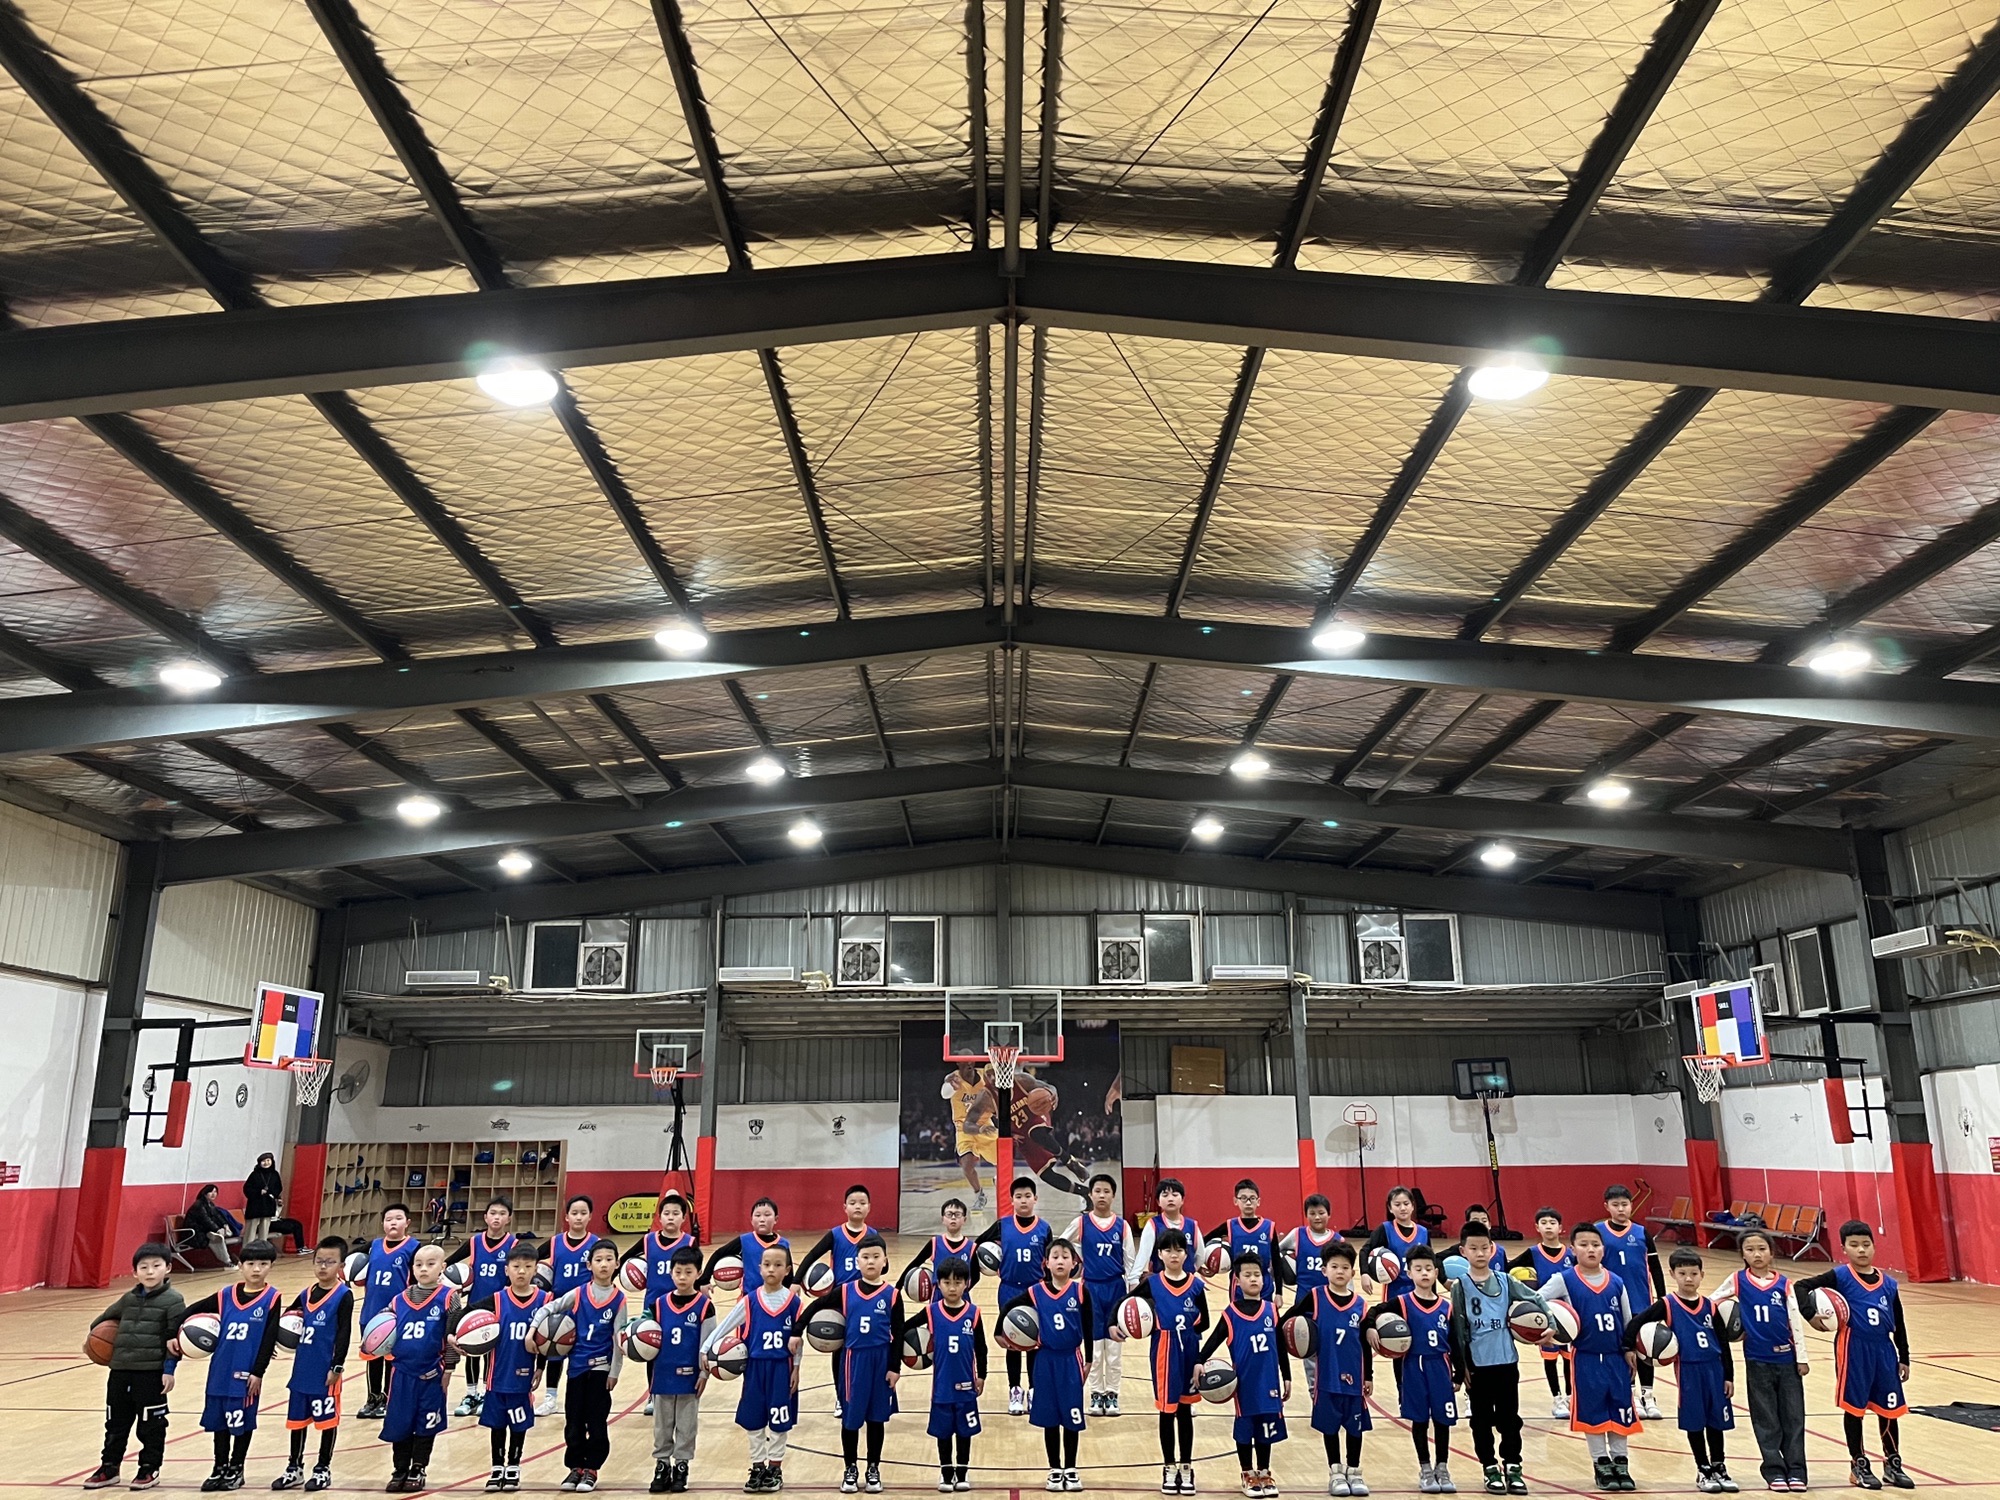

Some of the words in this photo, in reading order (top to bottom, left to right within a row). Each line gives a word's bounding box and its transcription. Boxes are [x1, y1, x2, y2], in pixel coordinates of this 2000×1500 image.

[1011, 1109, 1029, 1129] 23
[1016, 1248, 1031, 1262] 19
[1096, 1243, 1113, 1256] 77
[1619, 1251, 1625, 1265] 1
[479, 1263, 497, 1277] 39
[563, 1263, 579, 1278] 31
[1306, 1256, 1323, 1270] 32
[375, 1270, 392, 1286] 12
[1471, 1296, 1482, 1316] 8
[1753, 1304, 1770, 1322] 11
[859, 1316, 871, 1333] 5
[1053, 1313, 1065, 1330] 9
[1175, 1314, 1187, 1330] 2
[1594, 1313, 1615, 1332] 13
[1866, 1308, 1880, 1326] 9
[226, 1322, 249, 1341] 23
[402, 1321, 426, 1340] 26
[510, 1321, 527, 1341] 10
[586, 1324, 595, 1341] 1
[671, 1327, 682, 1345] 3
[1335, 1328, 1346, 1345] 7
[1427, 1329, 1439, 1347] 9
[1696, 1331, 1709, 1348] 6
[762, 1331, 784, 1350] 26
[948, 1335, 959, 1353] 5
[1250, 1333, 1270, 1353] 12
[311, 1396, 335, 1417] 32
[1887, 1391, 1898, 1408] 9
[225, 1409, 245, 1428] 22
[507, 1406, 527, 1425] 10
[770, 1405, 790, 1425] 20
[965, 1410, 978, 1428] 5
[1070, 1407, 1082, 1424] 9
[1445, 1402, 1455, 1418] 9
[1618, 1407, 1633, 1424] 13
